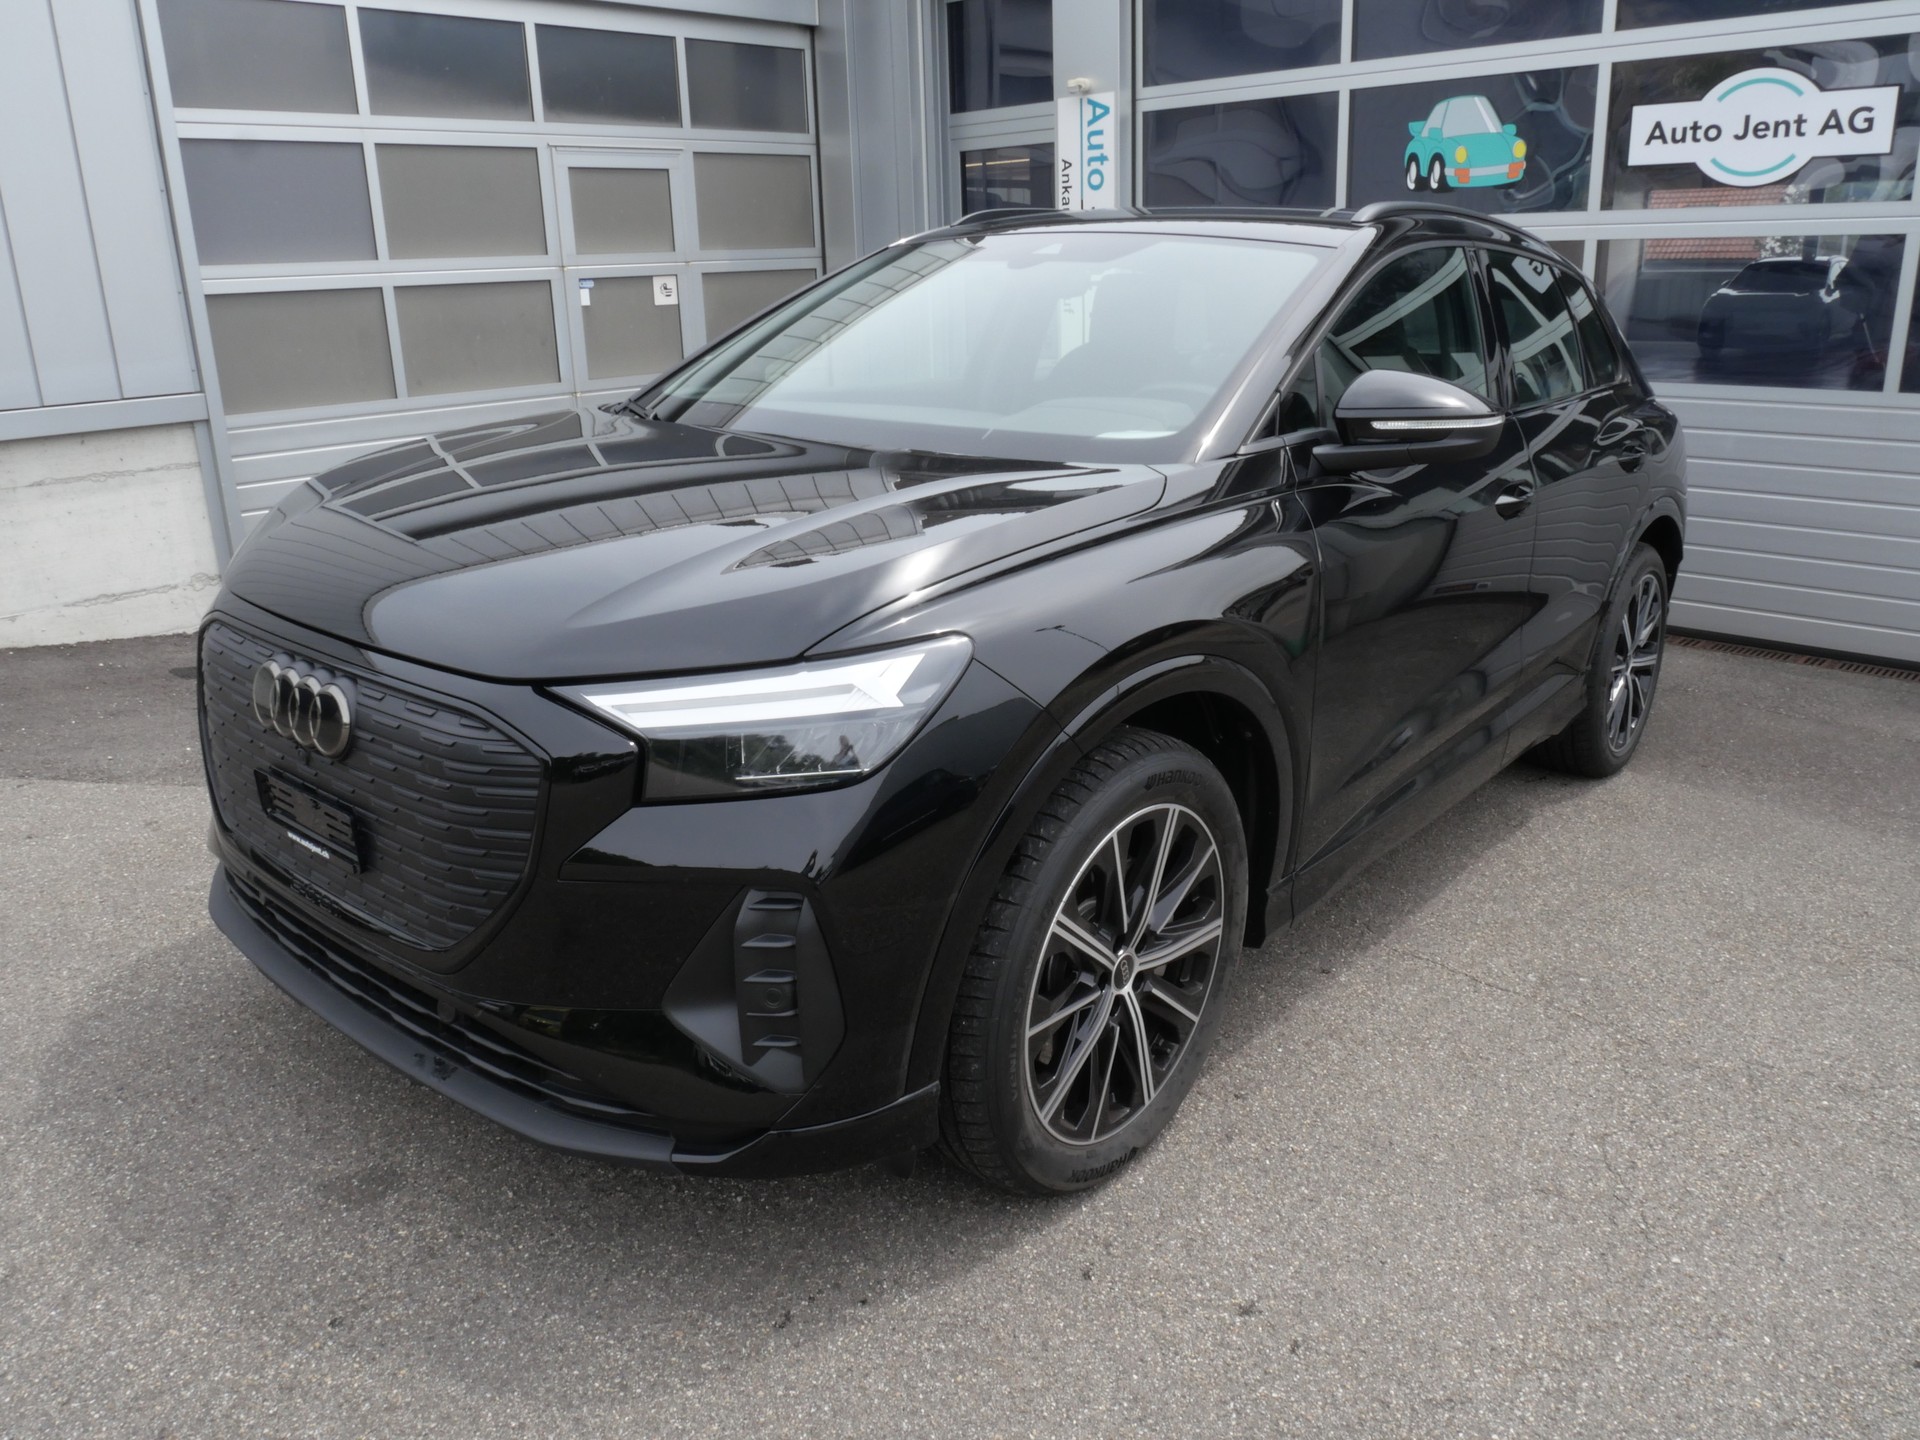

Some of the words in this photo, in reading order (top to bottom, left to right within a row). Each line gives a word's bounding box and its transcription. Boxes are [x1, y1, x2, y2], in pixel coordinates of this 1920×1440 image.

[1087, 98, 1110, 191] Auto
[1644, 120, 1722, 146] Auto
[1733, 113, 1808, 141] Jent
[1818, 106, 1875, 136] AG
[1061, 158, 1072, 210] Anka
